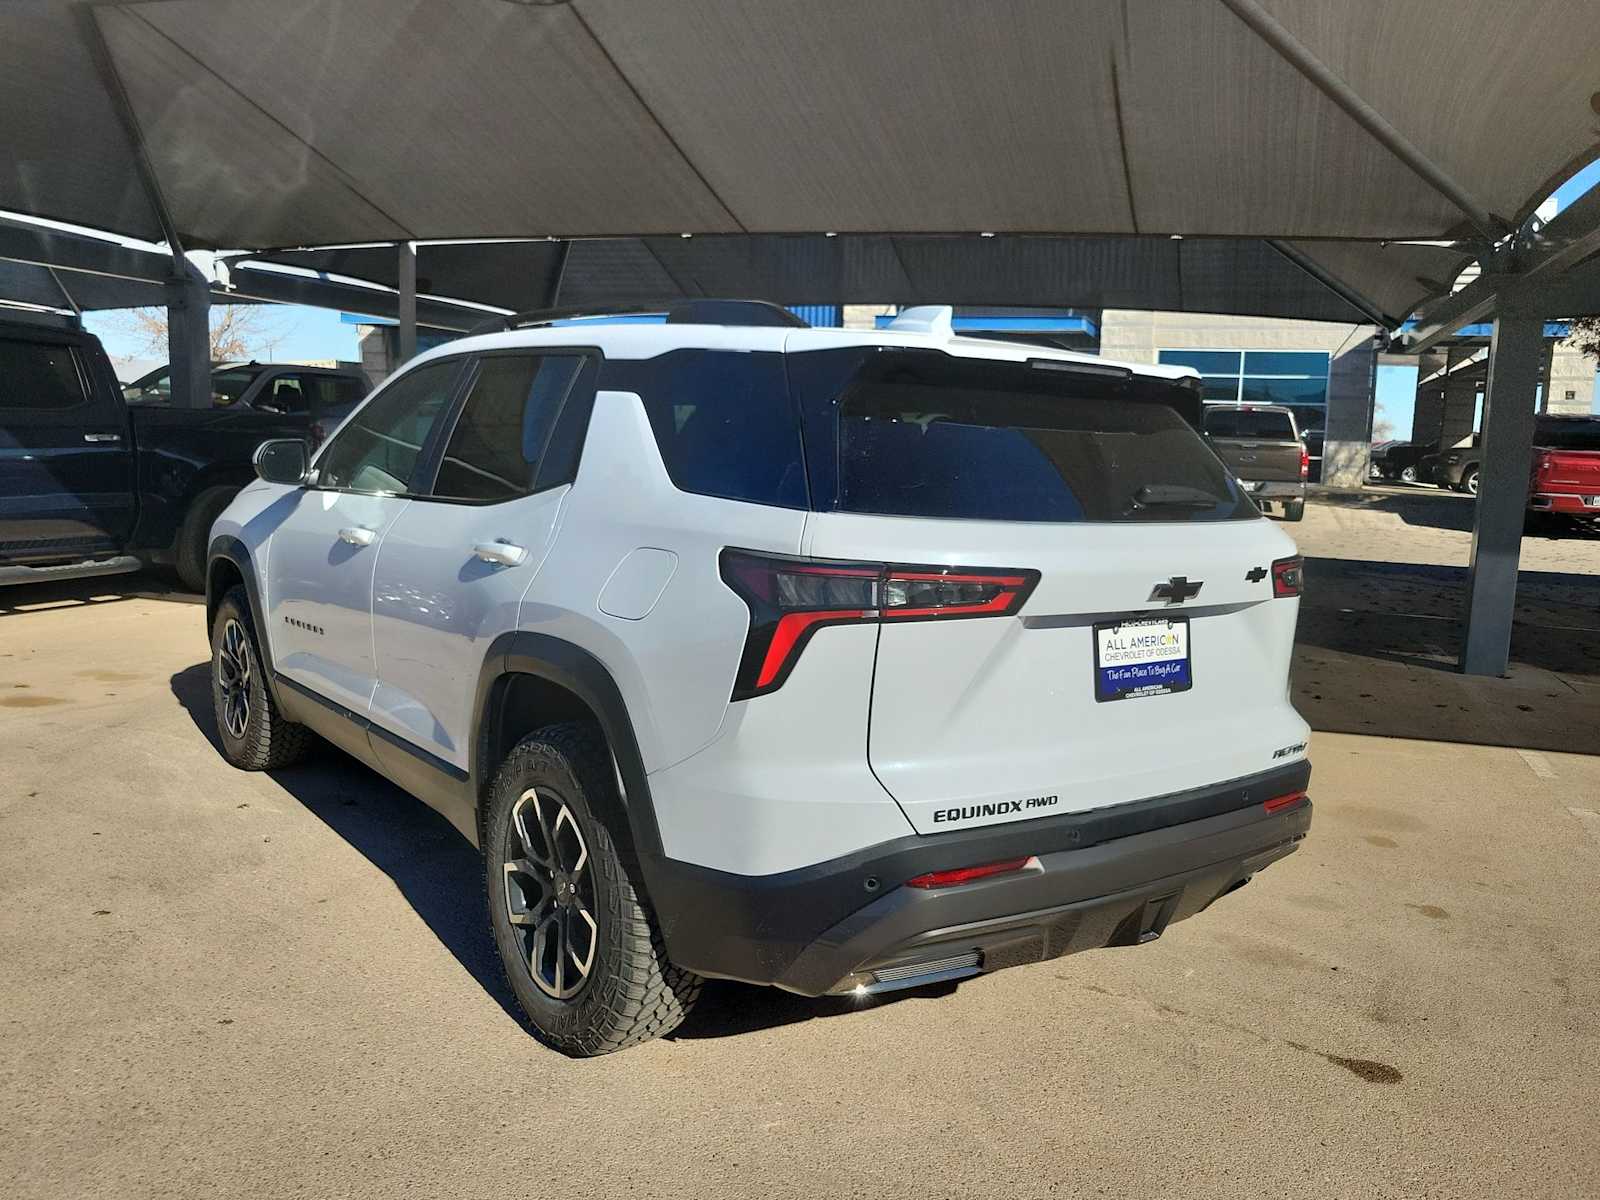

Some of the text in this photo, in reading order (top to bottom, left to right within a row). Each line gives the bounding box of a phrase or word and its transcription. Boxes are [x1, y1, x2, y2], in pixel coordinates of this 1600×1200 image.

[1106, 634, 1179, 650] ALL AMERICAN
[1105, 646, 1181, 661] CHEVROLET OF ODESSA
[1107, 670, 1119, 680] The
[1120, 669, 1131, 680] Fun
[1131, 667, 1147, 678] Place
[933, 795, 1058, 822] EQUINOX AWD
